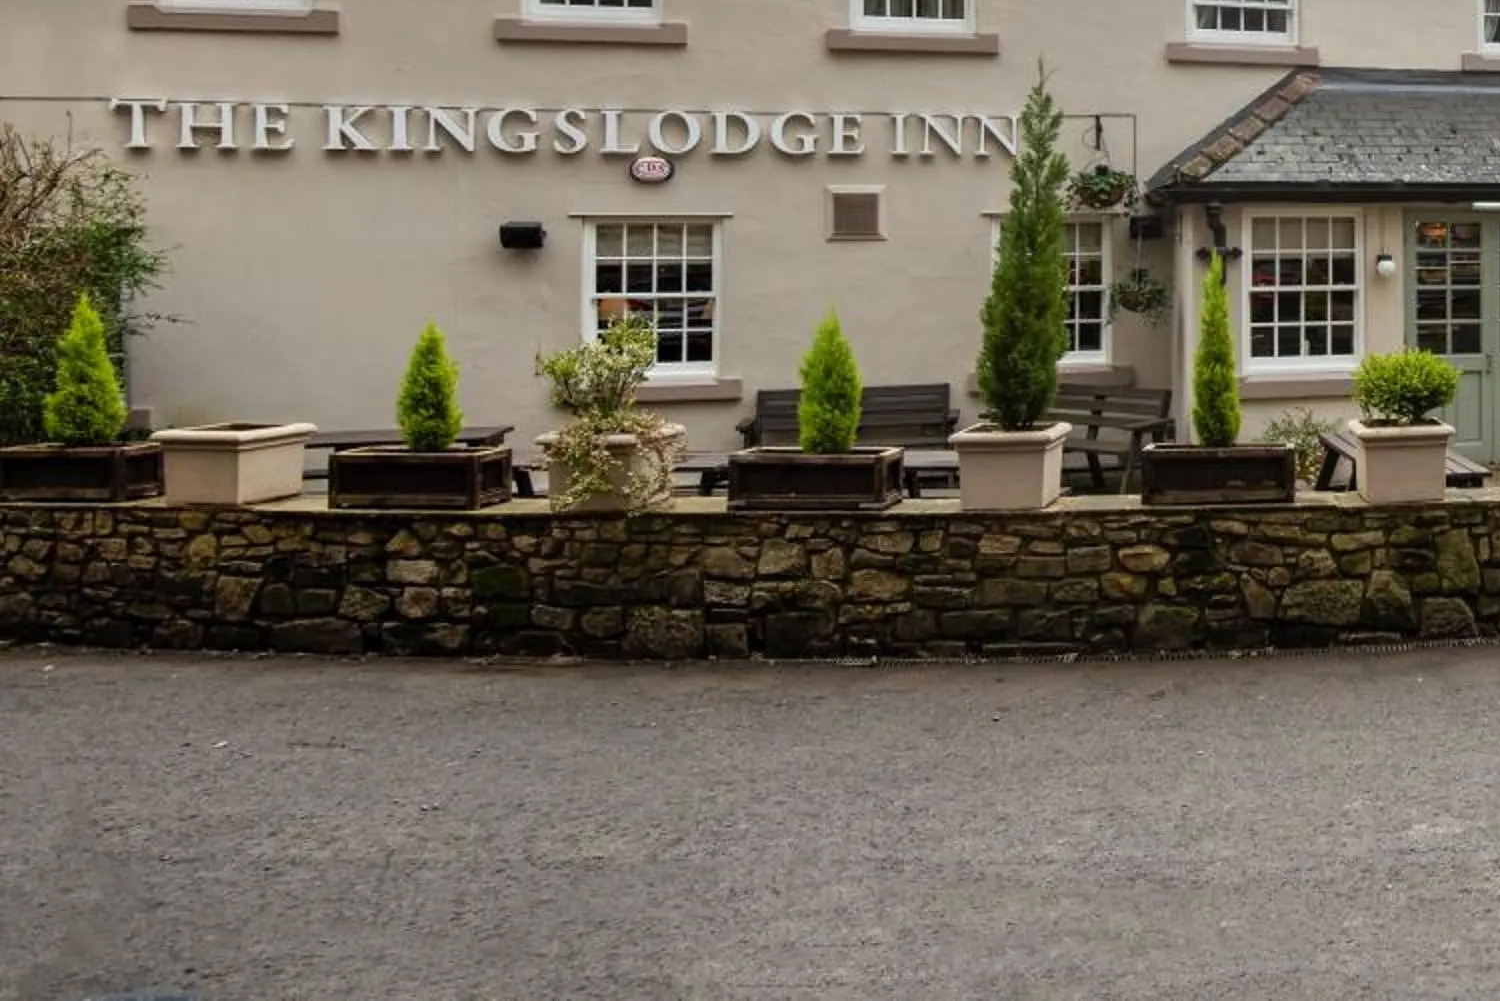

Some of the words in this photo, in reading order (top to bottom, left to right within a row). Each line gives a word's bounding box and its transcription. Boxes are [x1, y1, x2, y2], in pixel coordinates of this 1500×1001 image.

[111, 98, 296, 151] THE
[320, 104, 866, 157] KINGSLODGE
[889, 112, 1020, 157] INN
